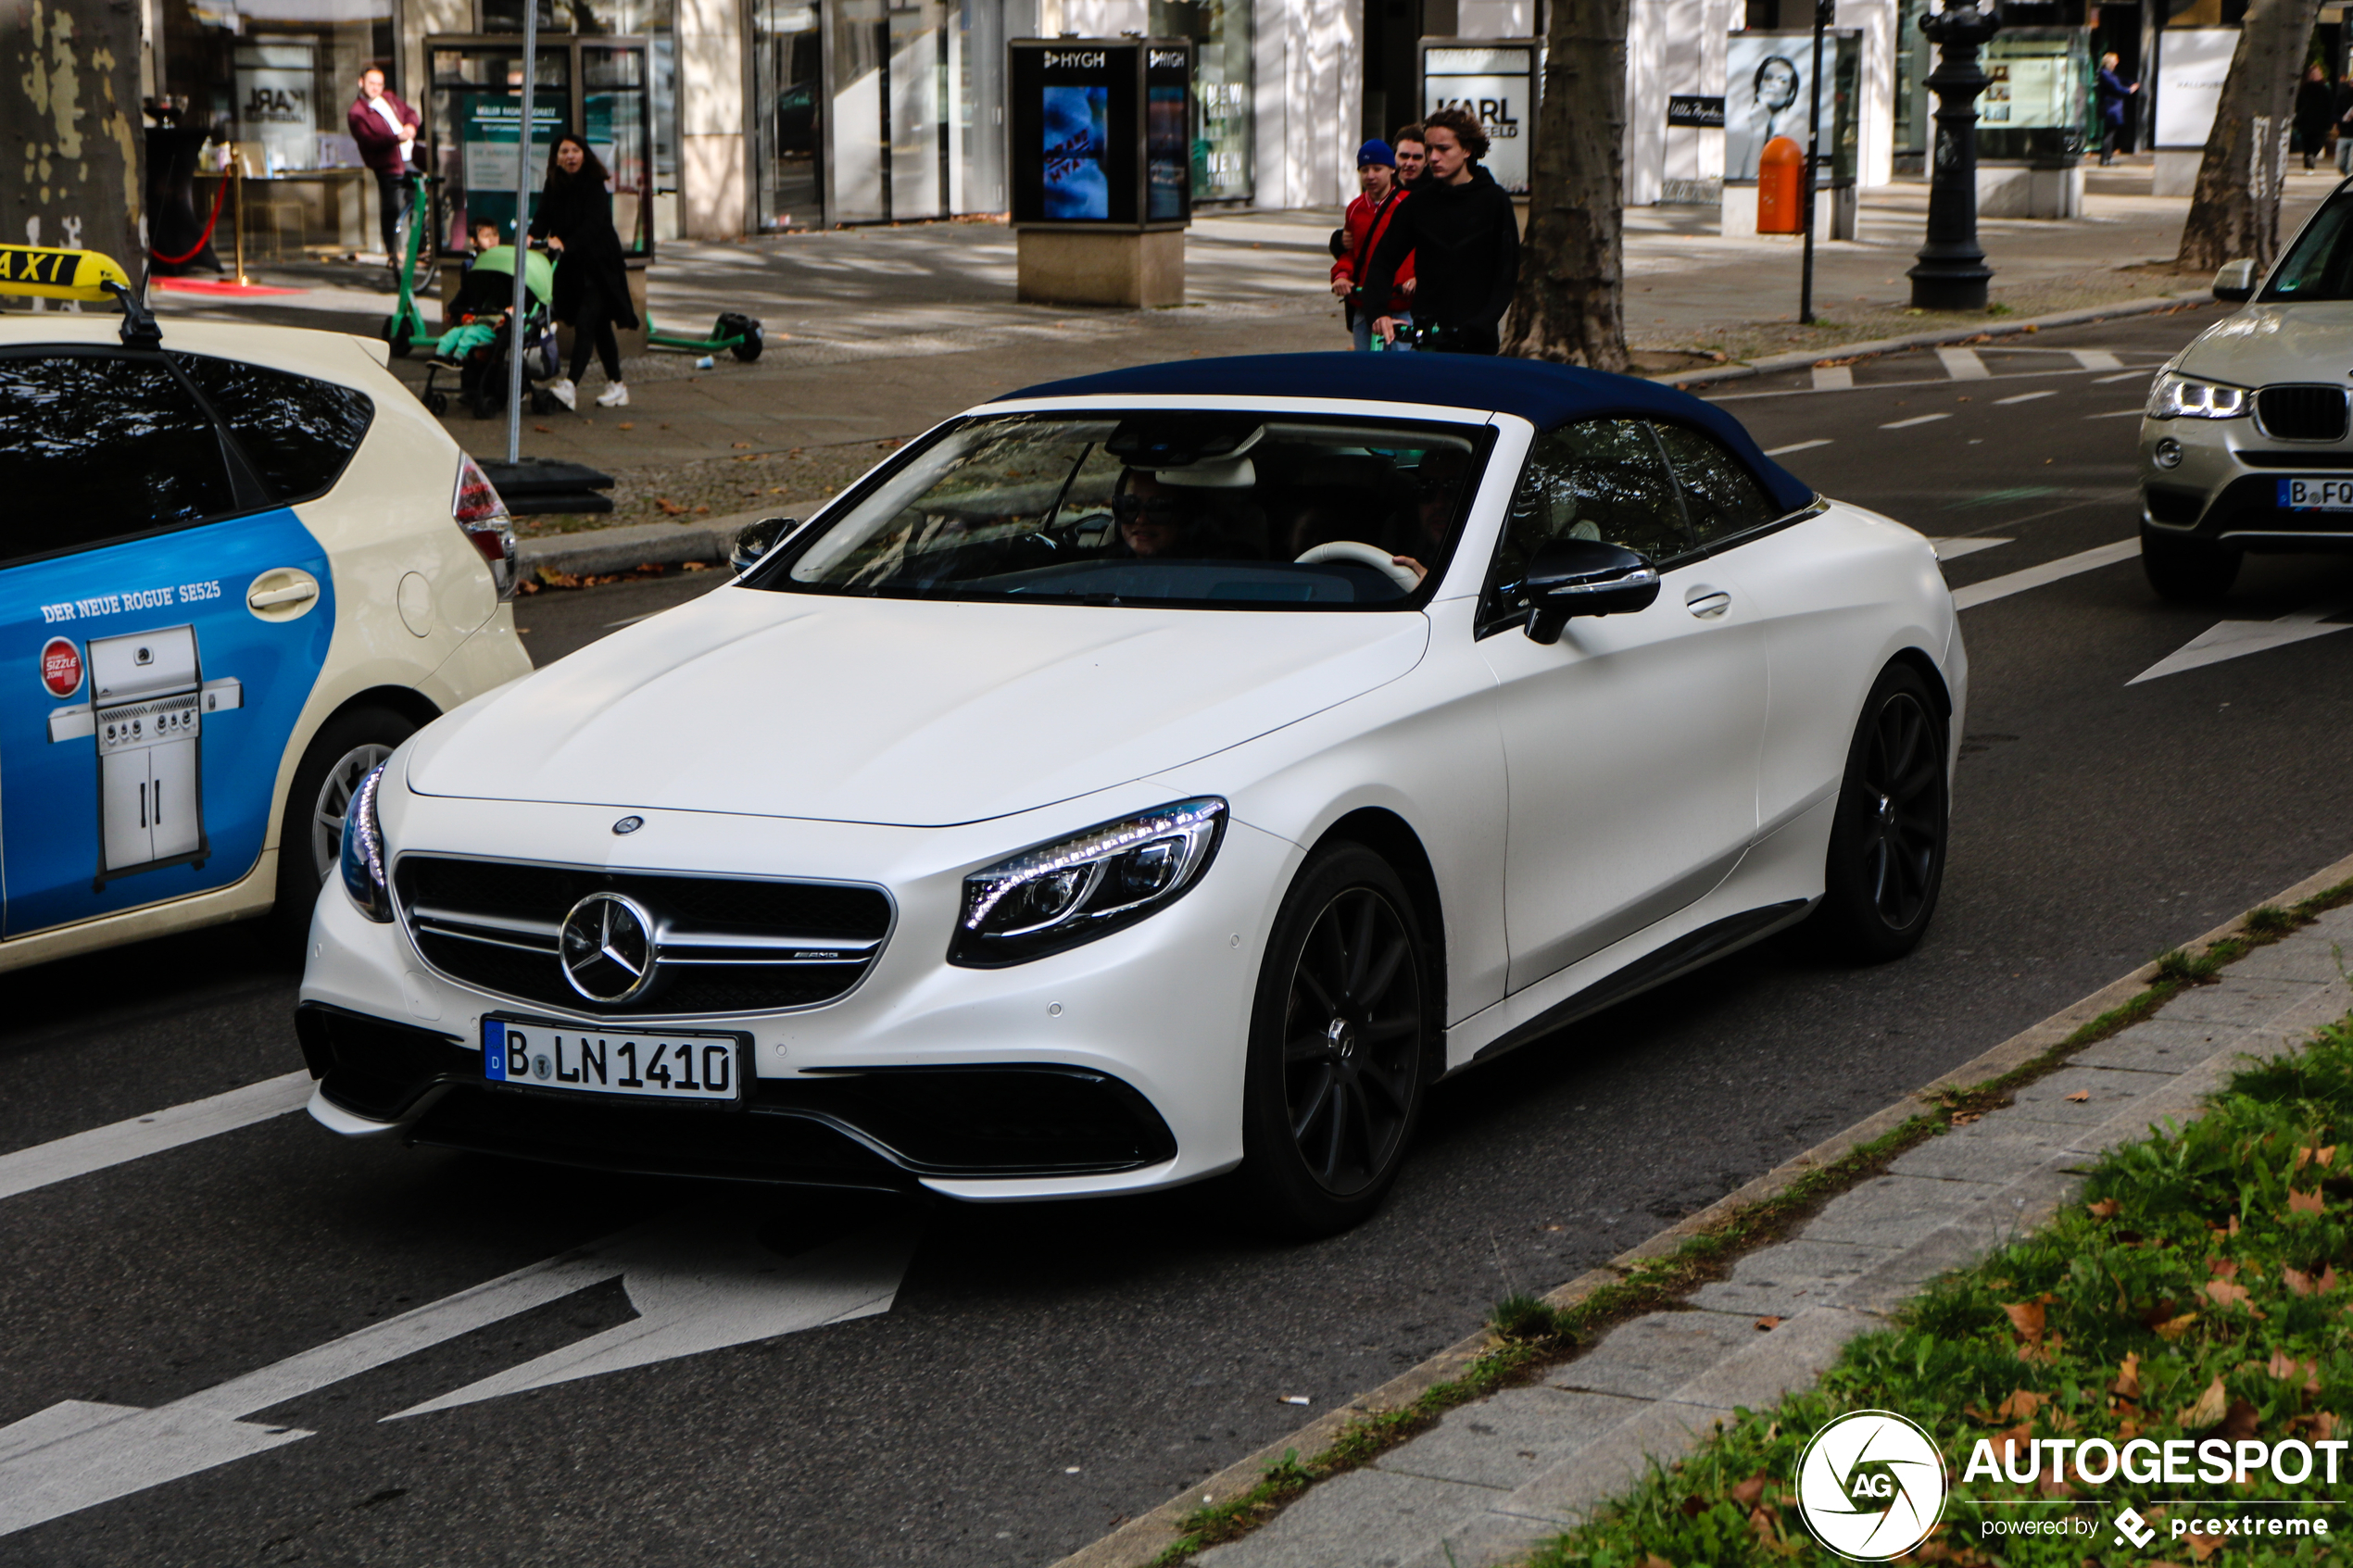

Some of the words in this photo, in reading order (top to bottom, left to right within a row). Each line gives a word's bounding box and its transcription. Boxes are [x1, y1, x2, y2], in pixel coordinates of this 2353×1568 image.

[1061, 52, 1106, 69] HYGH
[1158, 52, 1186, 68] HYGH
[1207, 83, 1243, 105] NEW
[1437, 97, 1518, 125] KARL
[1207, 152, 1242, 173] NEW
[0, 251, 65, 282] AXI
[2292, 482, 2307, 504] B
[41, 603, 76, 623] DER
[76, 596, 120, 618] NEUE
[179, 581, 220, 602] SE525
[46, 657, 78, 671] SIZZLE
[492, 1056, 499, 1069] D
[507, 1030, 529, 1076] B
